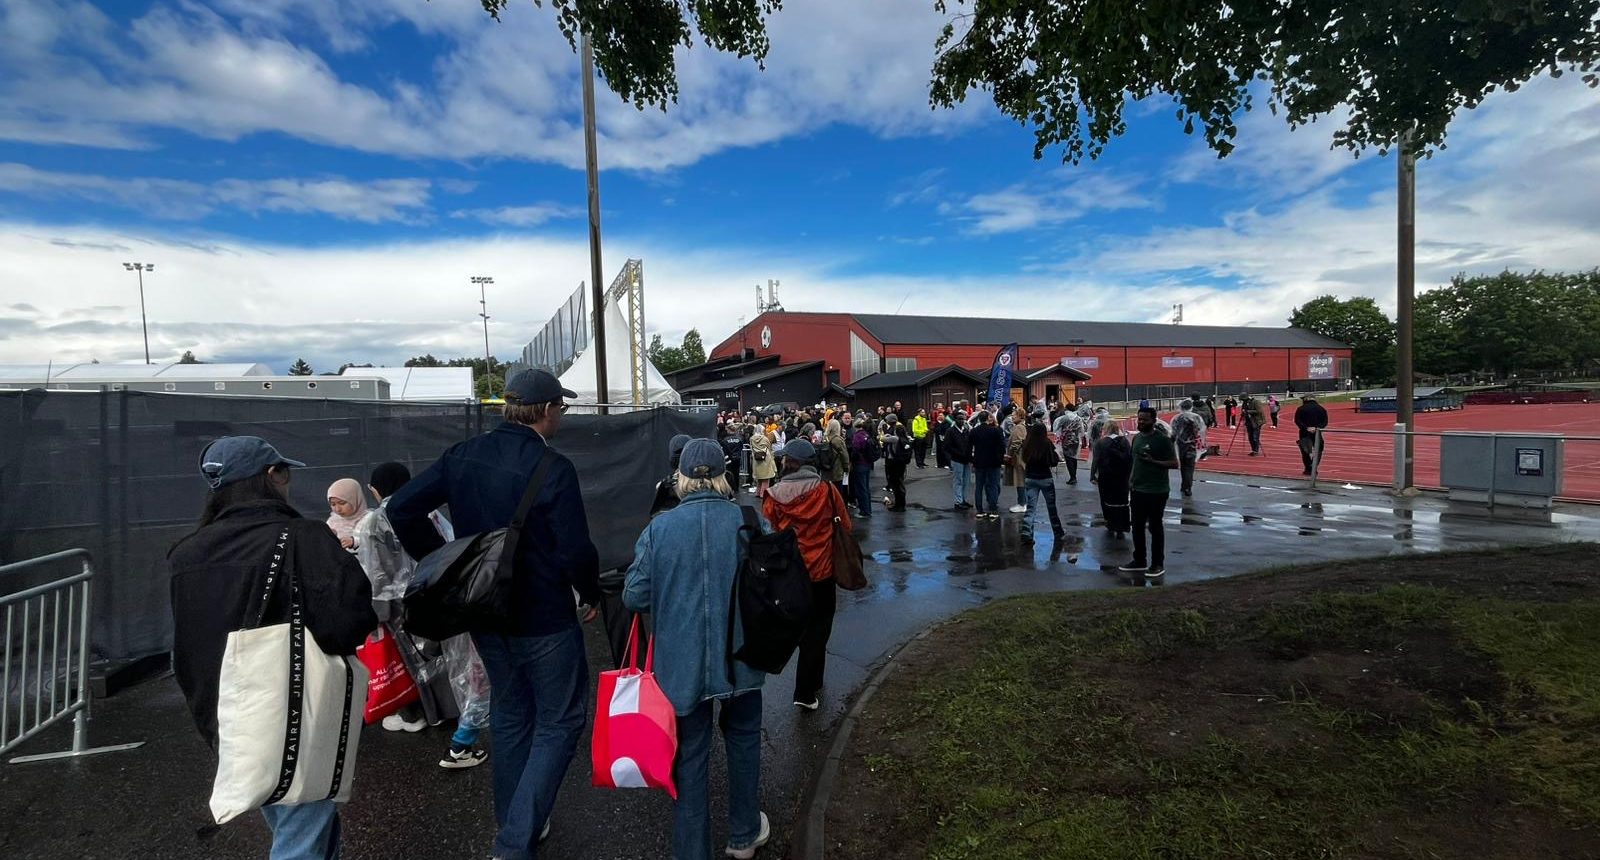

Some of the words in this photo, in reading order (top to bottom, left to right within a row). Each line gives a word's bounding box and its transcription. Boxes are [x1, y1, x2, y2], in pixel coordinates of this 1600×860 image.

[293, 602, 302, 647] FAIRLY
[293, 653, 302, 698] JIMMY
[287, 709, 300, 761] FAIRLY
